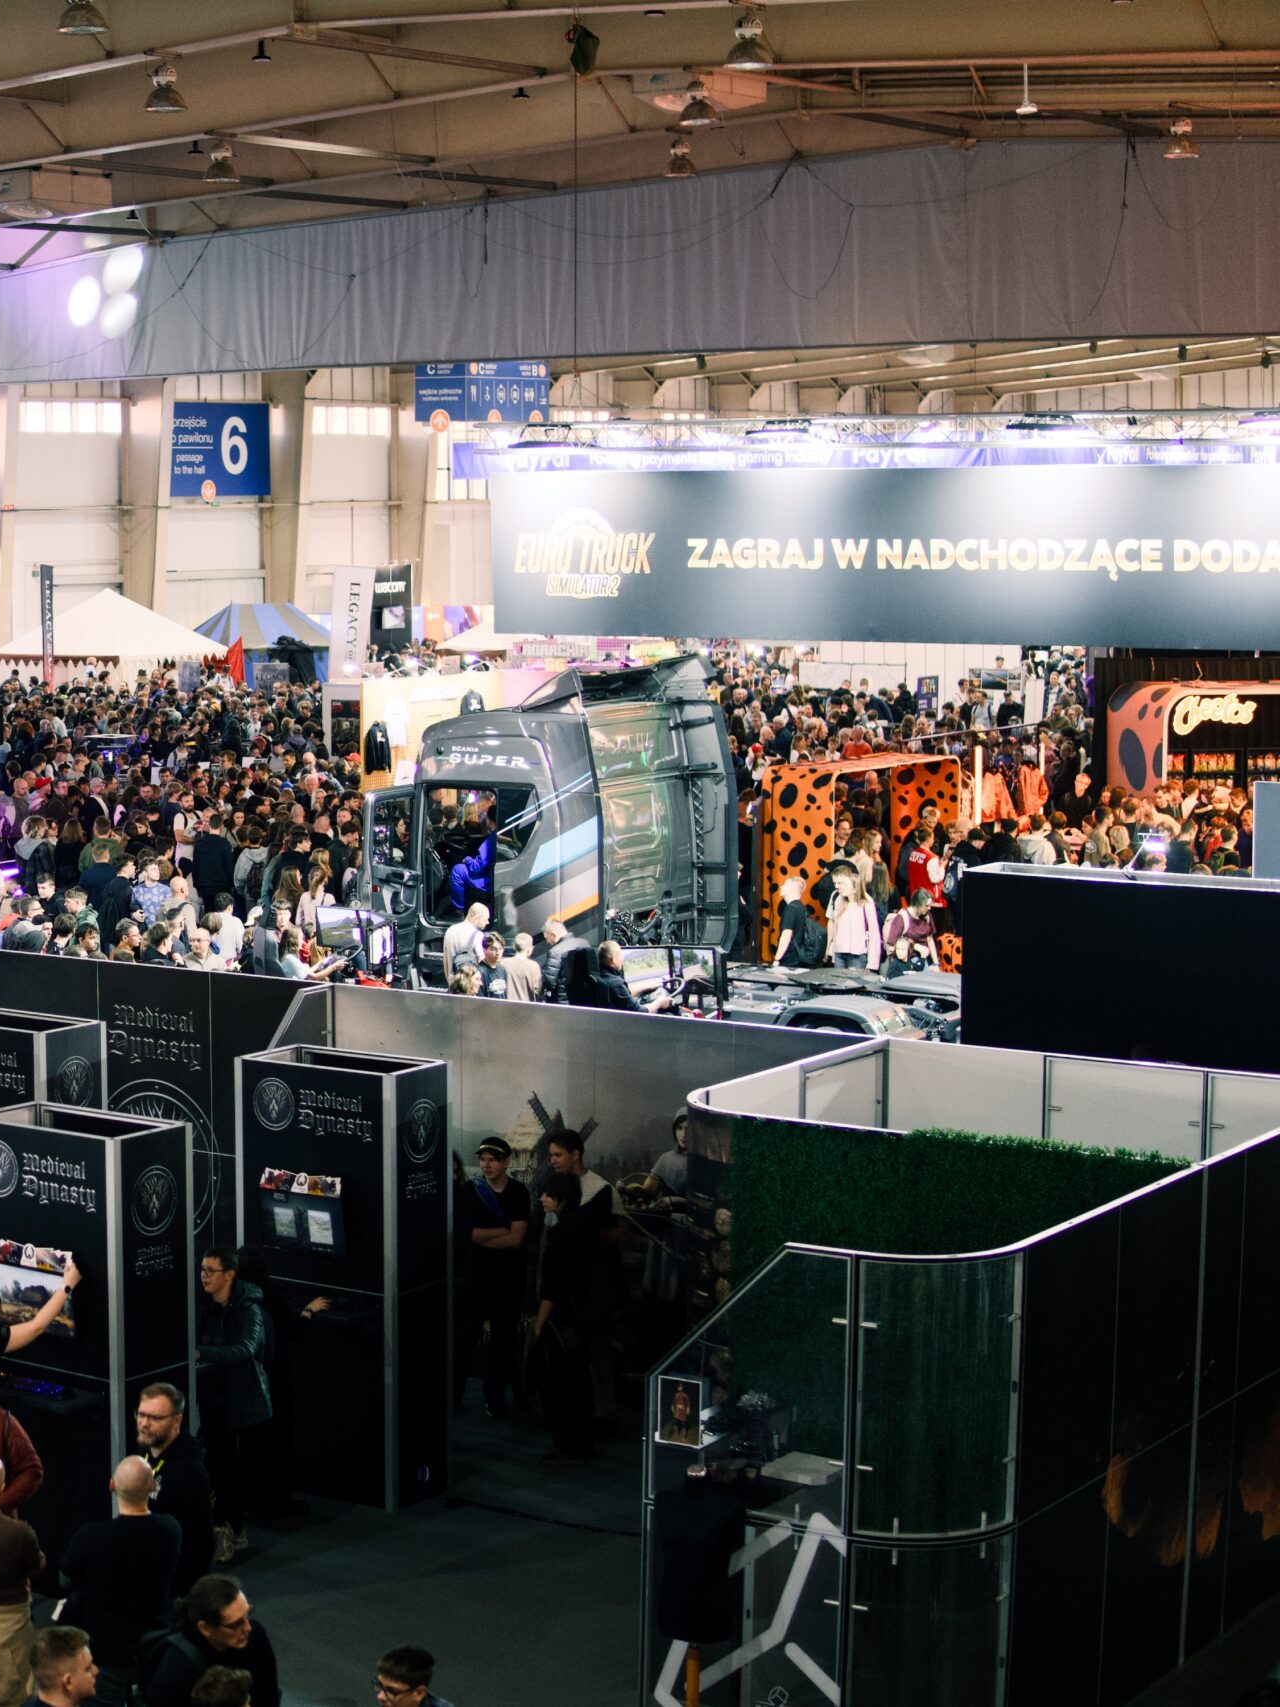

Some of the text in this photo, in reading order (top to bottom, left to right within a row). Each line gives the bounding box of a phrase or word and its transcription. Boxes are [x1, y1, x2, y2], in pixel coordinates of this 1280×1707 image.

[178, 432, 214, 445] pawilonu
[221, 416, 248, 475] 6
[176, 454, 203, 463] passage
[738, 453, 784, 466] gaming
[514, 532, 656, 574] EURO TRUCK
[687, 538, 823, 570] ZAGRAJ
[831, 539, 869, 569] W
[877, 538, 1163, 581] NADCHODZĄCE
[547, 575, 620, 597] SIMULATOR 2
[346, 582, 361, 648] LEGACY
[1172, 692, 1258, 736] Cheetos
[448, 753, 531, 770] SUPER
[451, 745, 479, 753] SCANIA
[113, 1003, 195, 1033] Medieval
[108, 1029, 203, 1071] Dynasty
[298, 1088, 364, 1113] Medieval
[297, 1108, 374, 1142] Dynasty
[22, 1152, 87, 1181] Medieval
[22, 1174, 98, 1214] Dynasty
